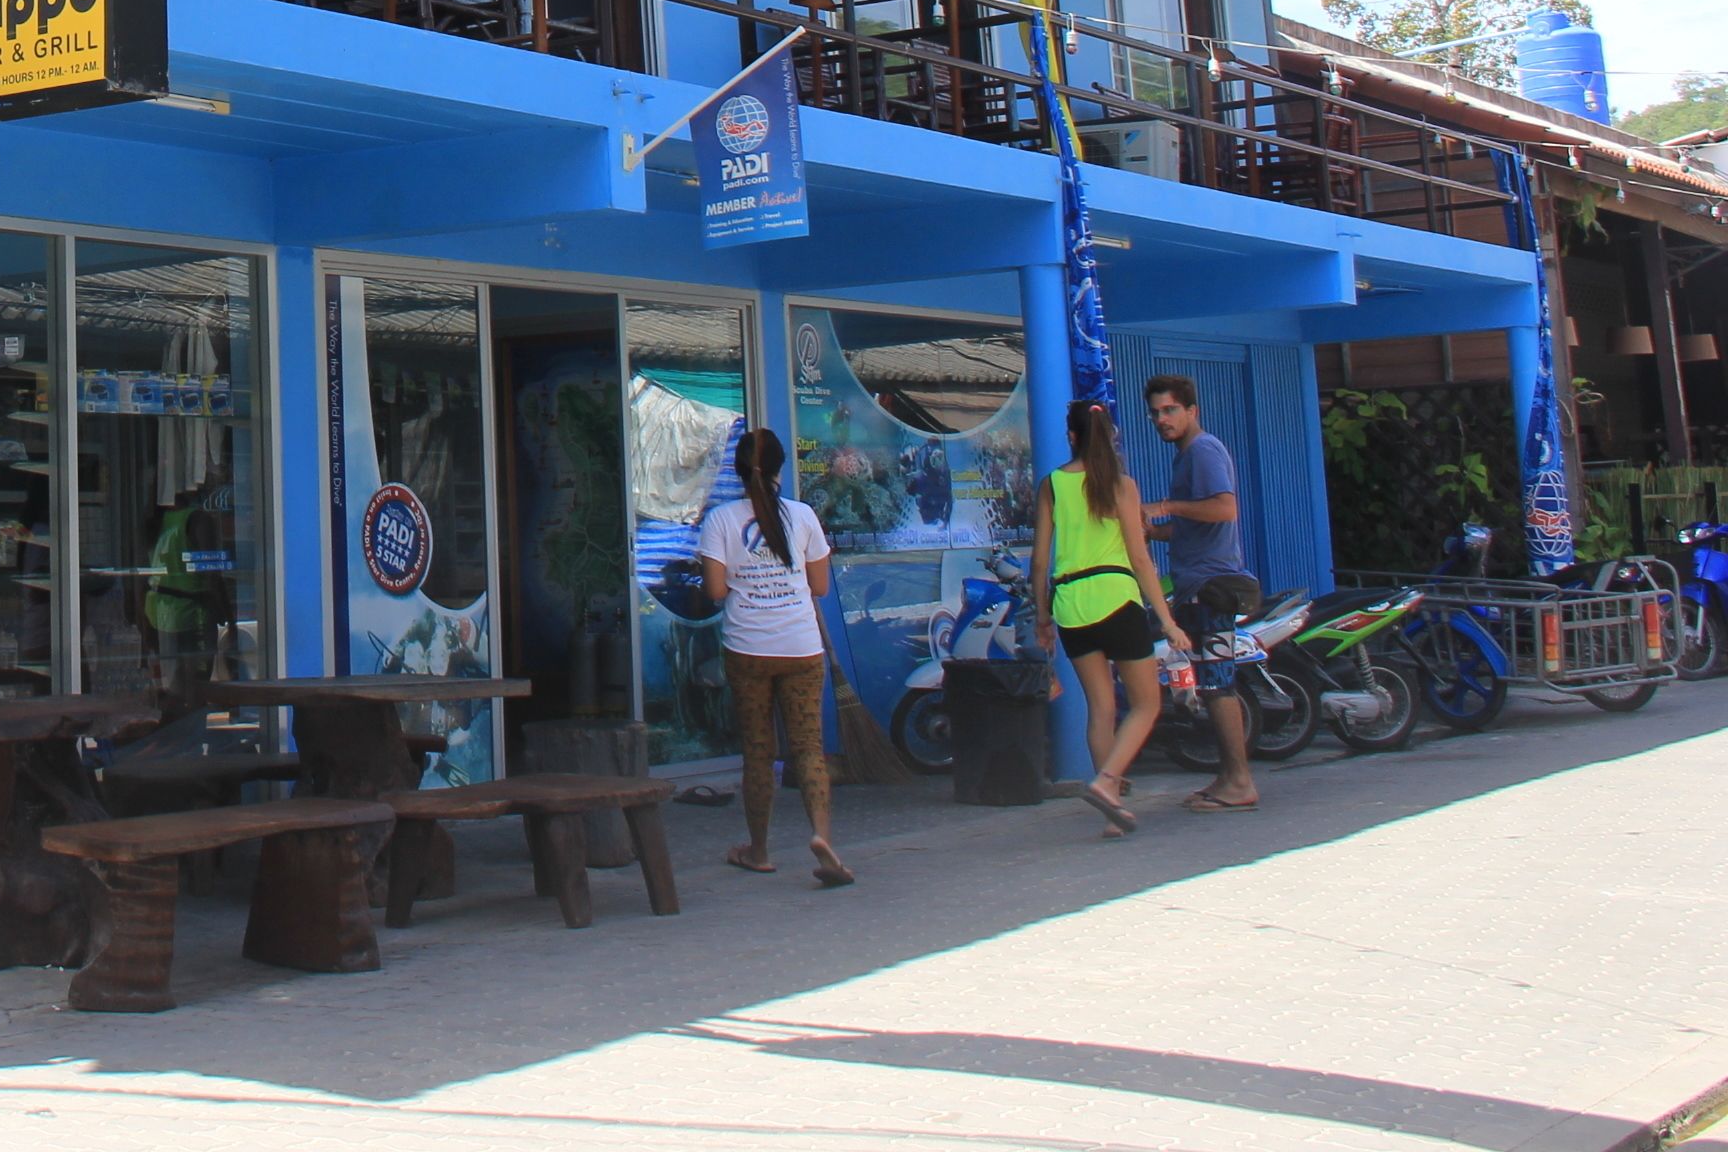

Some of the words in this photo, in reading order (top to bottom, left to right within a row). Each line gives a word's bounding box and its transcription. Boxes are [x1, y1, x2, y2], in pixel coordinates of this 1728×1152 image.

[12, 42, 25, 63] &
[34, 29, 99, 59] GRILL
[2, 70, 34, 86] HOURS
[36, 69, 46, 80] 12
[70, 64, 80, 75] 12
[721, 151, 769, 181] PADI
[723, 174, 769, 192] padi.com
[705, 196, 757, 217] MEMBER
[328, 300, 338, 320] The
[329, 323, 339, 355] Way
[330, 355, 338, 376] the
[330, 379, 339, 418] World
[800, 396, 823, 406] Center
[815, 386, 832, 396] Dive
[797, 438, 817, 451] Start
[332, 463, 339, 474] to
[378, 512, 415, 550] PADI
[375, 545, 383, 558] 5
[383, 549, 406, 573] STAR
[380, 573, 394, 587] Dive
[748, 589, 796, 600] Thailand
